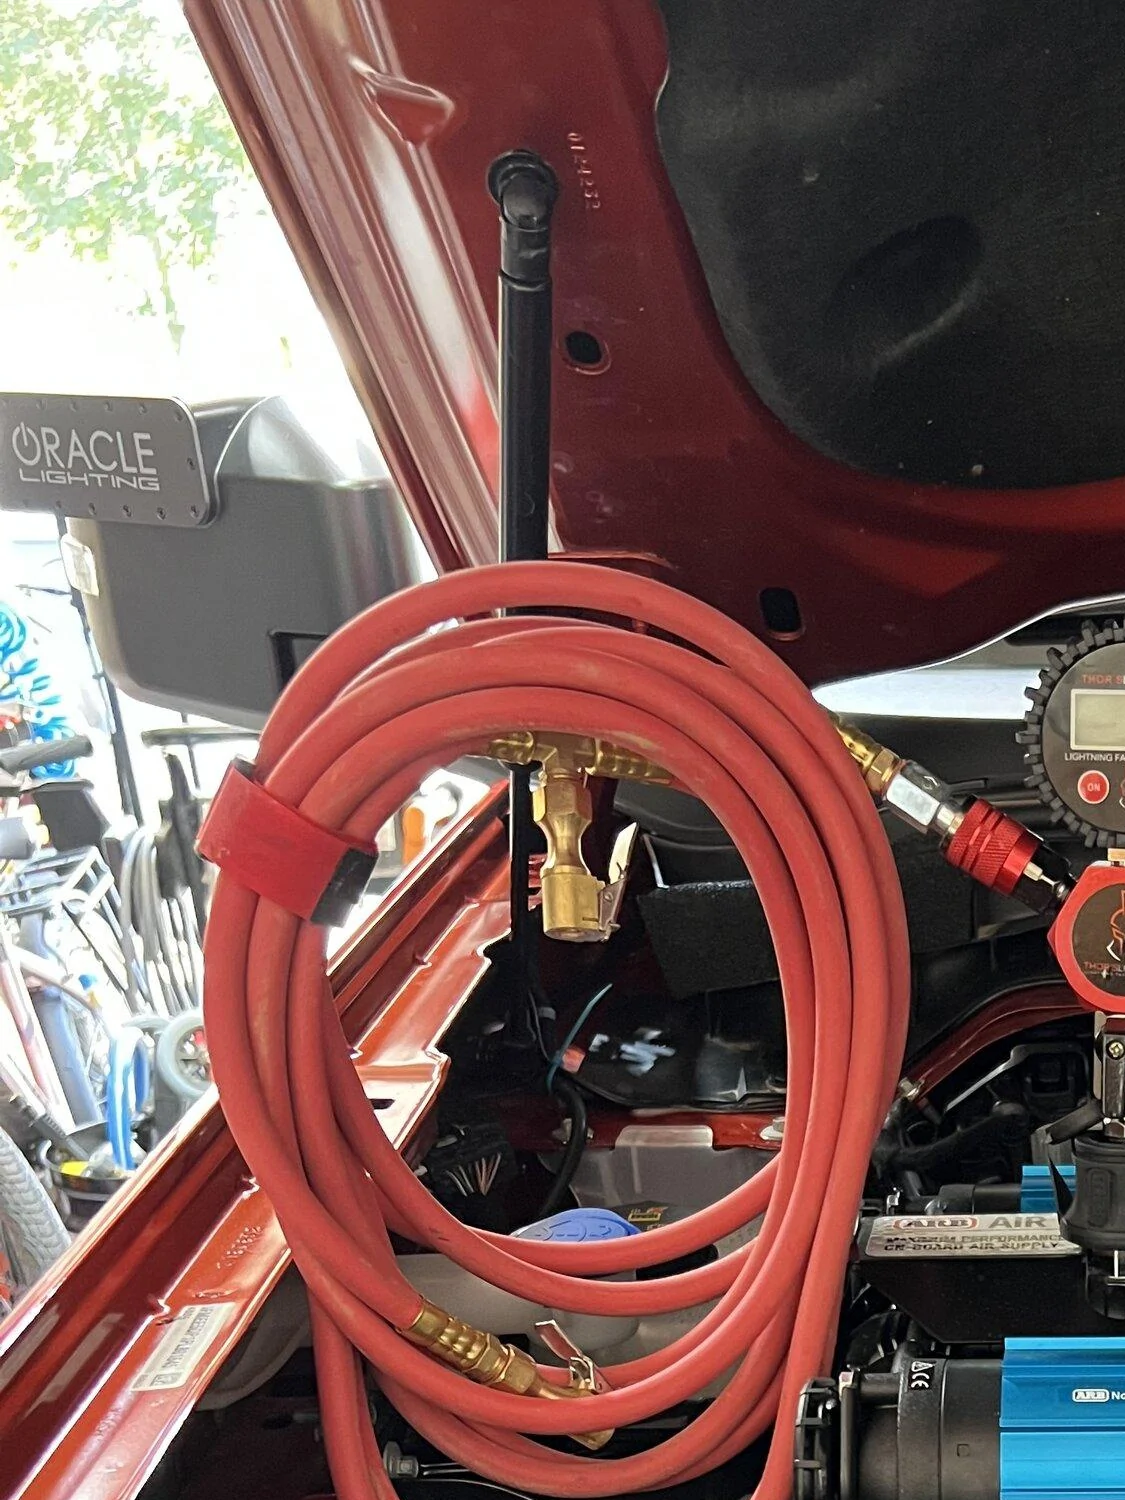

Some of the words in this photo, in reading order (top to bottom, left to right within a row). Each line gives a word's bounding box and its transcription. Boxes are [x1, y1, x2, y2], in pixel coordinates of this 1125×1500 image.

[12, 421, 157, 475] ORACLE
[18, 467, 160, 491] LIGHTING
[1064, 752, 1113, 762] LIGHTNING
[1086, 783, 1101, 792] ON
[988, 1216, 1047, 1228] AIR
[1002, 1241, 1059, 1250] SUPPLY
[1074, 1390, 1107, 1401] ARB
